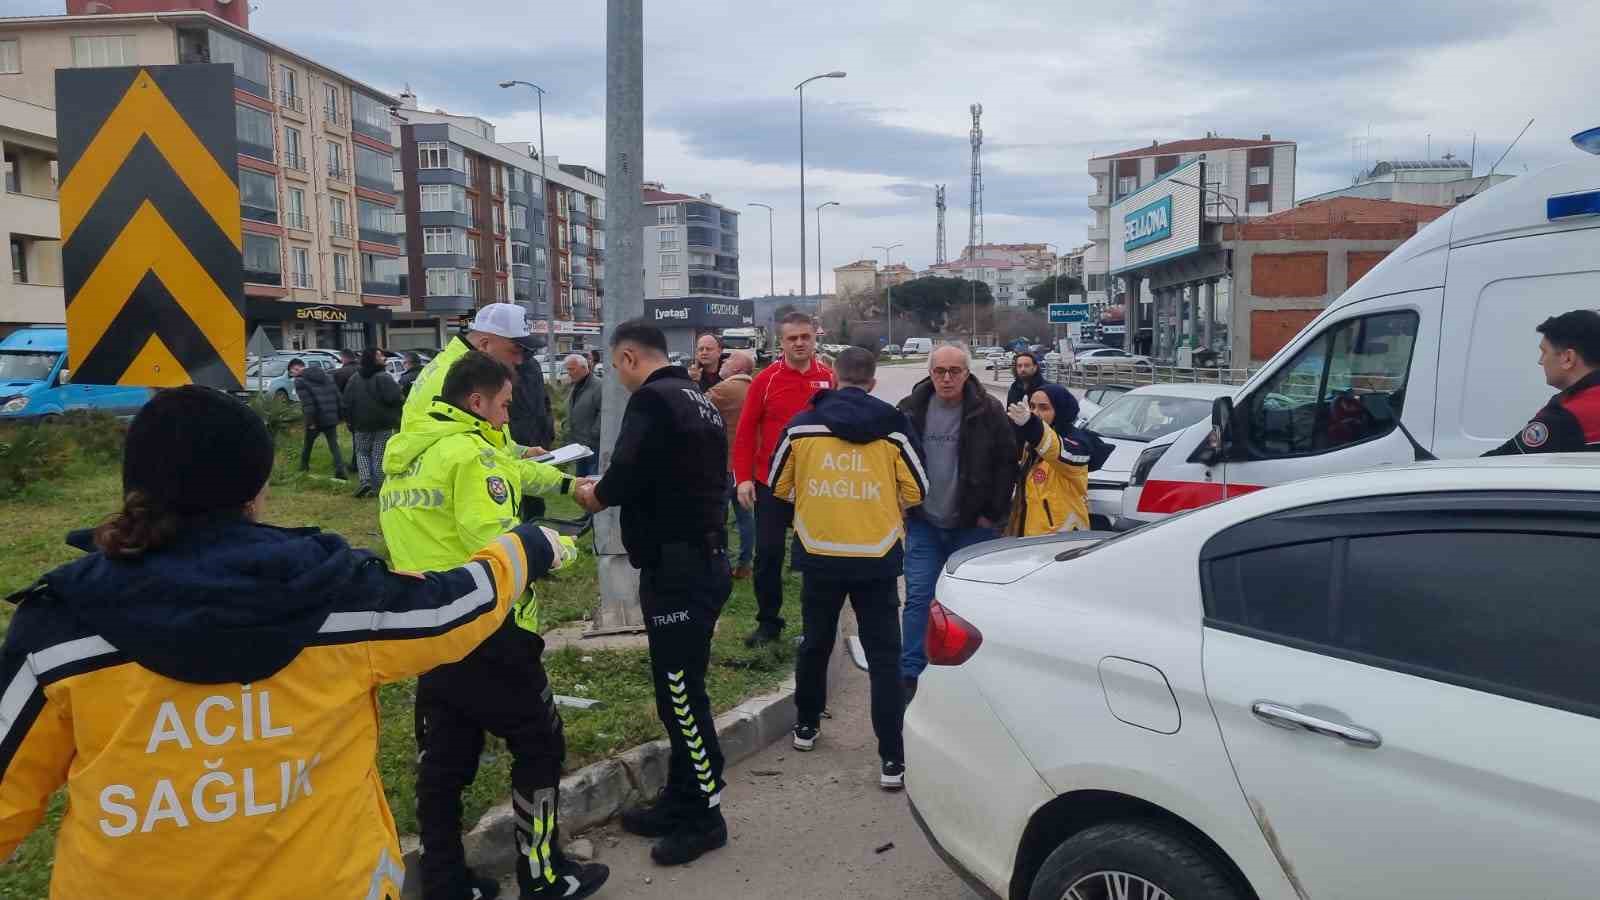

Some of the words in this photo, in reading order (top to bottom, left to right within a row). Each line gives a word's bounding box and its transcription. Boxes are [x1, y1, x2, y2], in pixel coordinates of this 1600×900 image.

[1125, 206, 1168, 241] BELLONA
[1051, 310, 1089, 319] BELLONA
[821, 450, 871, 472] ACİL
[807, 477, 881, 500] SAĞLIK
[145, 684, 294, 753] ACİL
[99, 752, 321, 838] SAĞLIK
